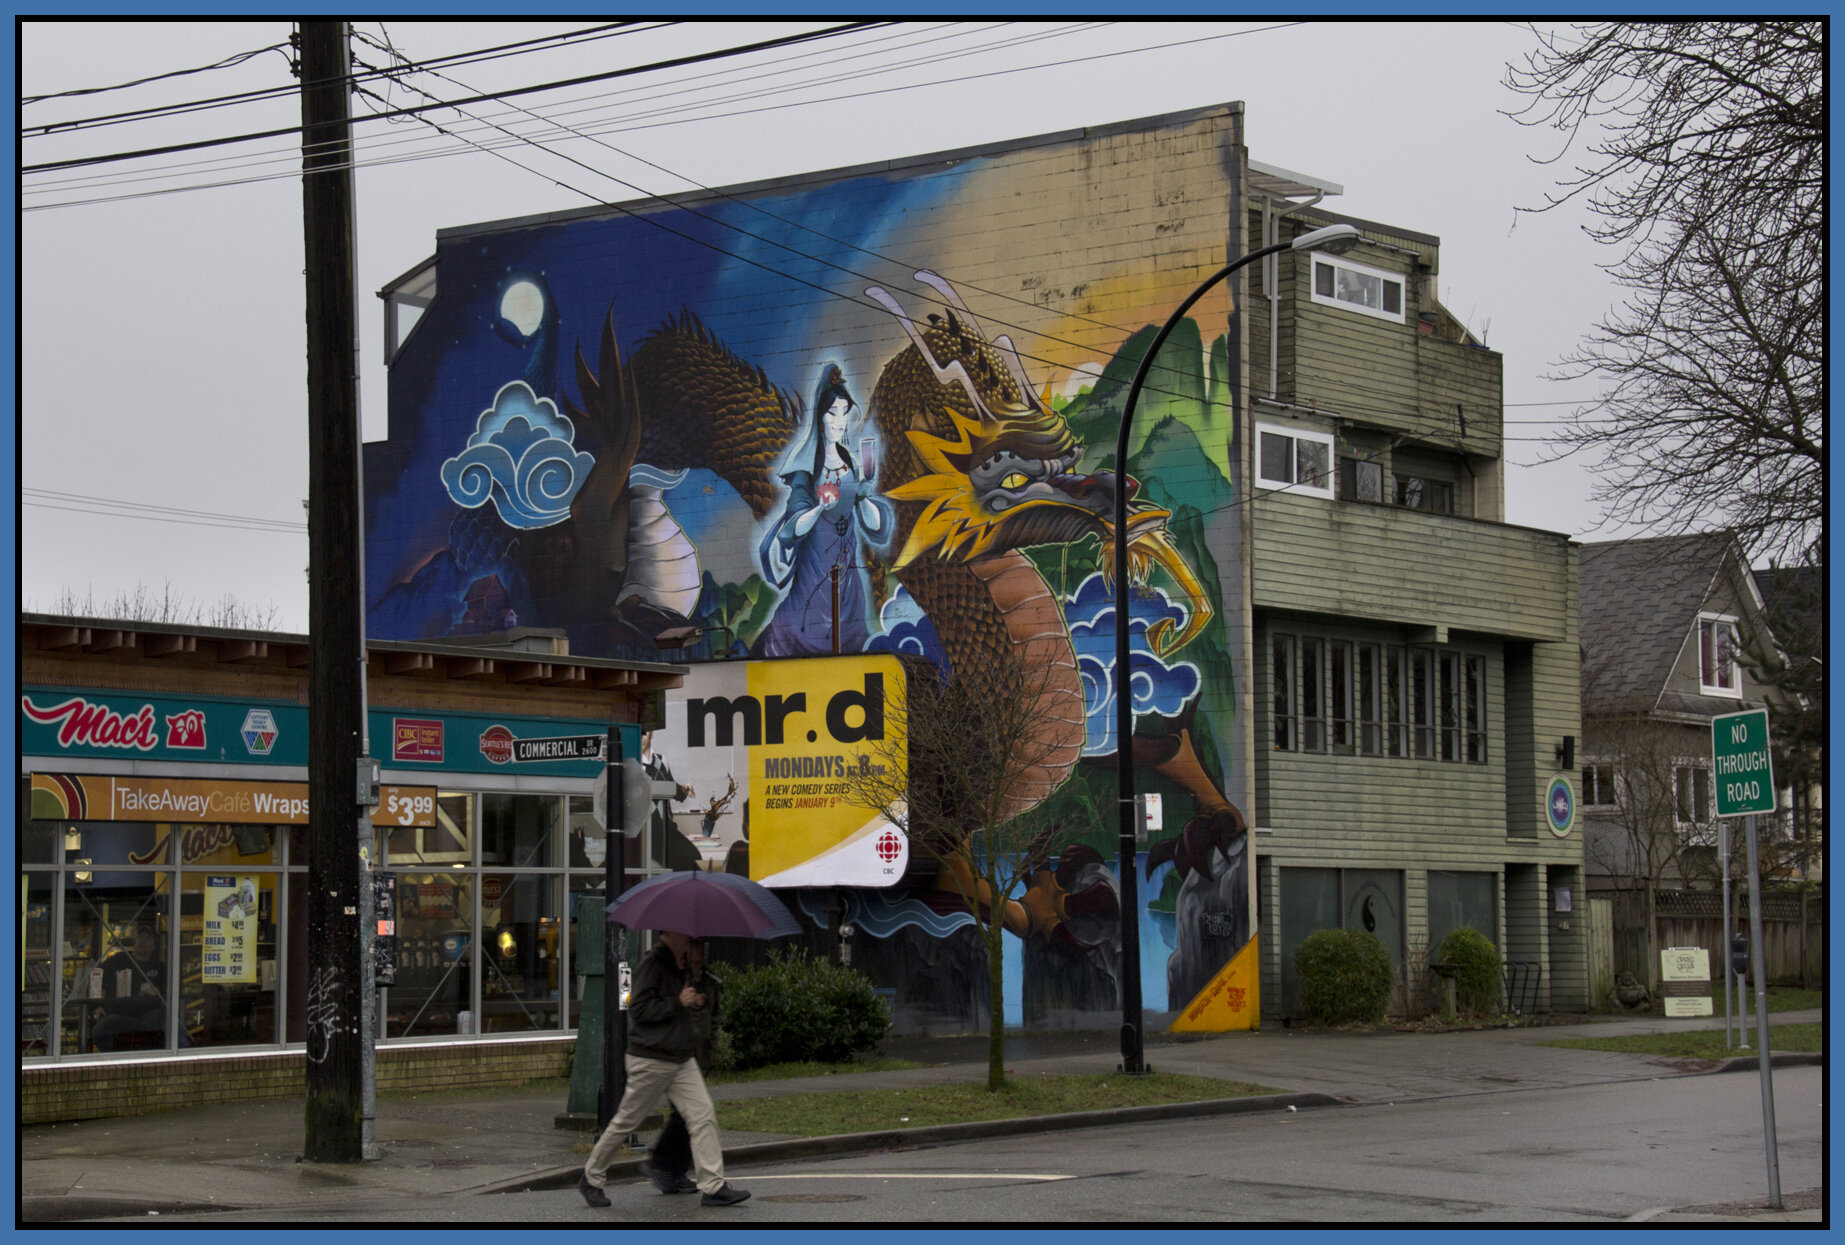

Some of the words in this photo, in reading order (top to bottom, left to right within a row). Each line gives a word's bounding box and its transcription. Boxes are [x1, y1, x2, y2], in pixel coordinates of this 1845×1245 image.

[687, 672, 885, 748] mr.d
[22, 697, 158, 751] Mac's
[398, 728, 418, 740] CIBC
[1731, 724, 1748, 744] NO
[519, 741, 579, 759] COMMERCIAL
[581, 746, 598, 755] 2600
[764, 755, 845, 779] MONDAYS
[1716, 751, 1767, 775] THROUGH
[765, 785, 771, 795] A
[772, 784, 790, 795] NEW
[791, 784, 823, 795] COMEDY
[824, 783, 852, 795] SERIES
[1727, 781, 1760, 802] ROAD
[253, 793, 309, 819] Wraps
[766, 798, 794, 809] BEGINS
[794, 797, 829, 809] JANUARY
[206, 921, 221, 929] MILK
[205, 937, 226, 946] BREAD
[204, 953, 221, 962] EGGS
[204, 966, 227, 975] BUTTER
